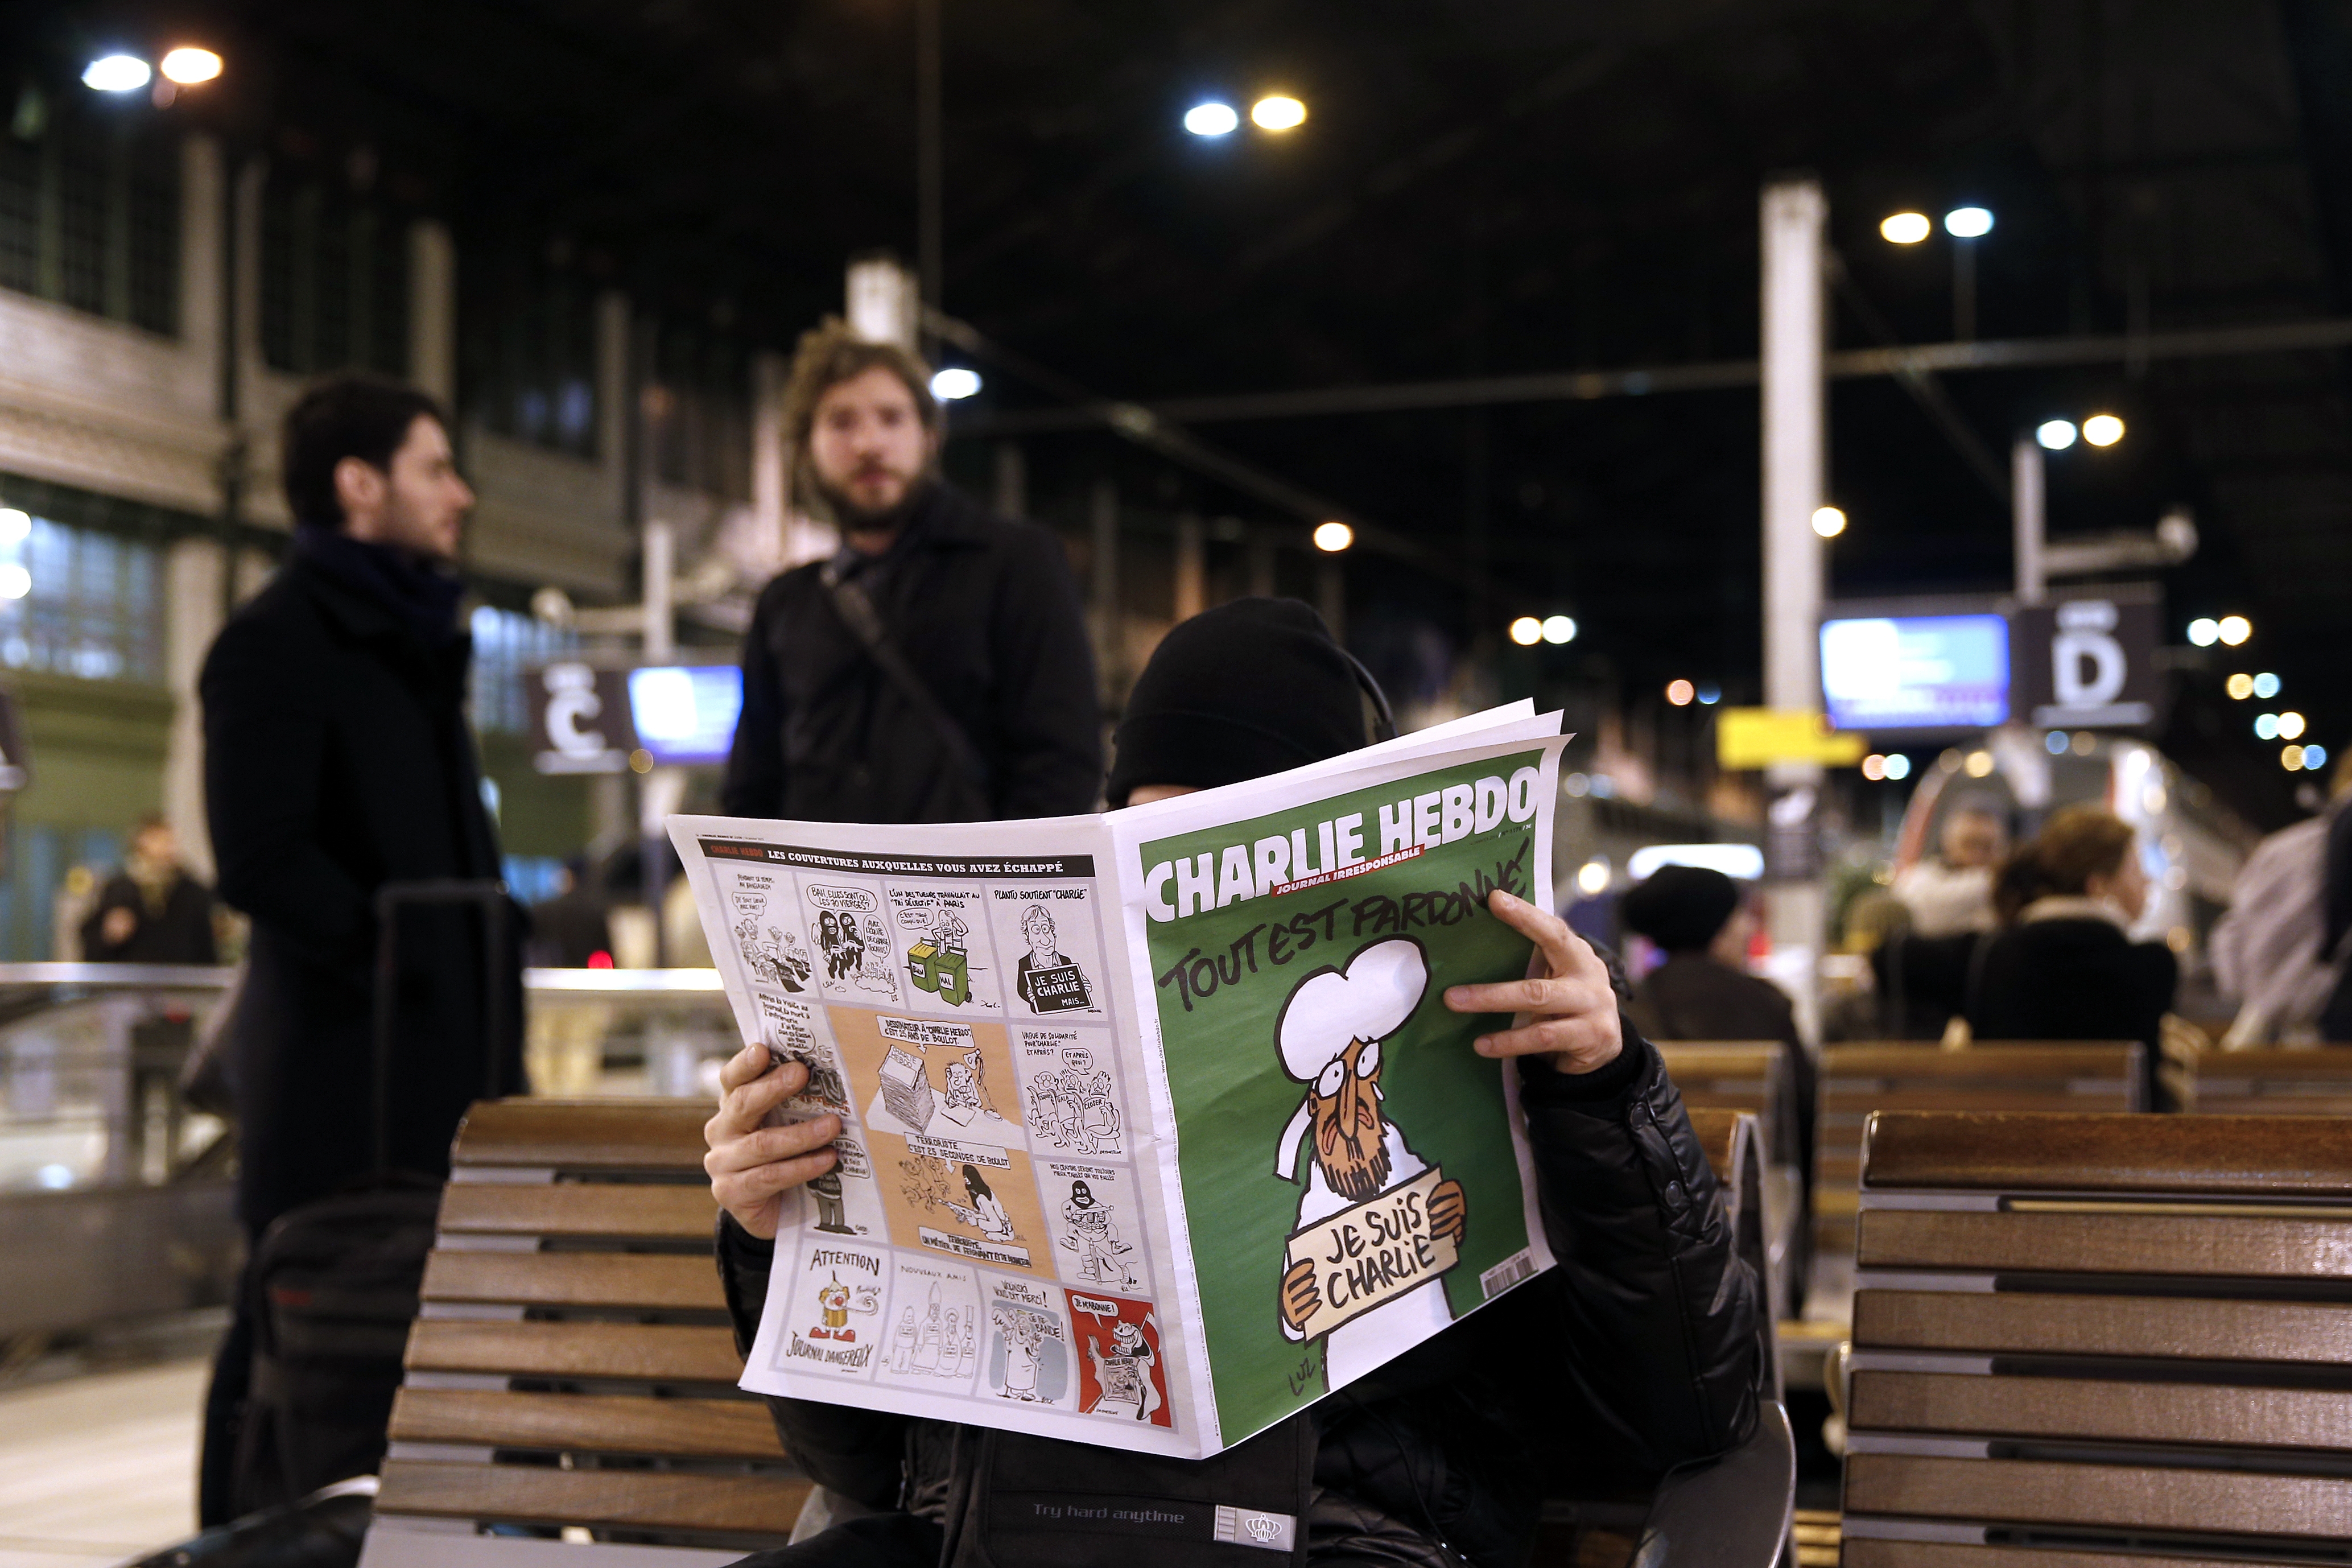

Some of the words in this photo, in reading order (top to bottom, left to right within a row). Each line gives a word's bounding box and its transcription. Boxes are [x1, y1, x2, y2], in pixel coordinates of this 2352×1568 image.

[2053, 633, 2128, 707] D
[546, 690, 605, 751] C
[710, 844, 739, 855] CHARLIE
[740, 847, 764, 857] HEBDO
[1144, 812, 1365, 923] CHARLIE
[1378, 766, 1540, 860] HEBDO
[768, 850, 786, 860] LES
[789, 852, 859, 868] COUVERTURES
[861, 860, 934, 872] AUXQUELLES
[935, 863, 967, 873] VOUS
[969, 864, 1001, 873] AVEZ
[1004, 861, 1064, 873] ÉCHAPPÉ
[1276, 875, 1331, 896] JOURNAL
[1332, 847, 1421, 881] IRRESPONSABLE
[819, 897, 830, 906] LES
[832, 899, 840, 907] 70
[844, 891, 860, 901] SONT
[994, 889, 1018, 899] PLANTU
[1157, 923, 1268, 1013] TOUT
[1268, 898, 1350, 965] EST
[939, 976, 952, 986] MAL
[1034, 975, 1047, 987] JE
[1050, 970, 1076, 982] SUIS
[1037, 981, 1080, 997] CHARLIE
[907, 1031, 919, 1041] ANS
[1021, 1031, 1039, 1040] VAGUE
[1072, 1050, 1089, 1059] APRÈS
[1154, 1018, 1166, 1074] www.charliehebdo.fr
[1084, 1099, 1103, 1110] CLOSER
[927, 1146, 937, 1156] 25
[939, 1149, 975, 1162] SECONDES
[976, 1154, 986, 1164] DE
[987, 1157, 1008, 1166] BOULOT
[1326, 1225, 1366, 1264] JE
[809, 1249, 880, 1277] ATTENTION
[900, 1265, 942, 1278] NOUVEAUX
[947, 1273, 967, 1282] AMIS
[1074, 1297, 1082, 1307] JE
[786, 1330, 824, 1362] JOURNAL
[824, 1344, 874, 1367] DANGEREUX
[1288, 1357, 1315, 1397] LUZ
[1033, 1503, 1062, 1519] Try
[1068, 1504, 1107, 1519] hard
[1112, 1509, 1186, 1524] anytime
